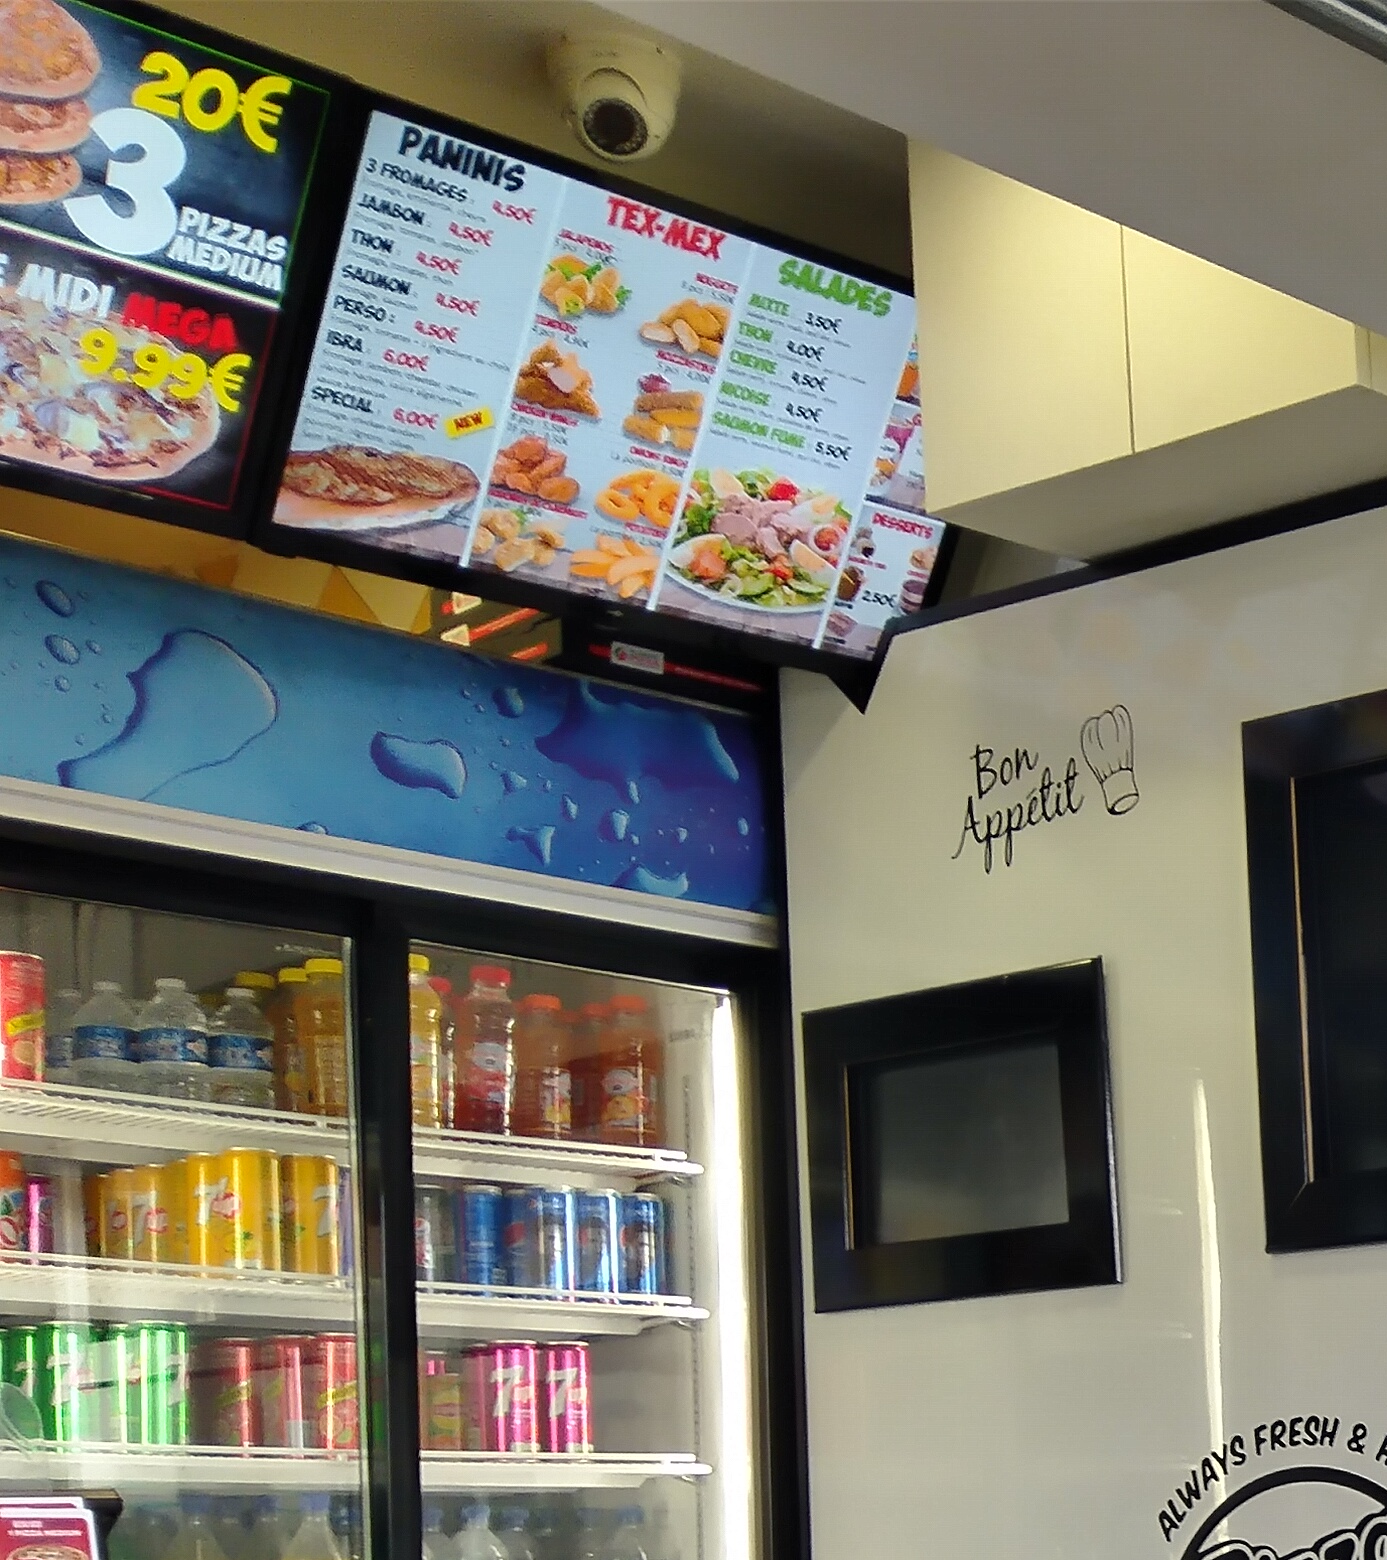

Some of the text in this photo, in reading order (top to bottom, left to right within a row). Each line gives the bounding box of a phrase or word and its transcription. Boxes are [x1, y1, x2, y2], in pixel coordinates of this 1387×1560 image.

[131, 50, 293, 154] 20€
[63, 107, 187, 256] 3
[365, 158, 378, 173] 3
[380, 162, 468, 202] FROMAGES
[397, 125, 527, 191] PANINIS
[178, 205, 289, 261] PIZZAS
[357, 192, 425, 226] JAMBON
[606, 195, 727, 262] TEX-MEX
[166, 235, 285, 292] MEDIUM
[350, 228, 395, 254] THON
[16, 263, 116, 320] MIDI
[121, 292, 238, 354] MEGA
[333, 293, 387, 322] PERSO
[778, 258, 893, 318] SALADES
[325, 328, 364, 353] IBRA
[78, 328, 253, 413] 9.99€
[310, 385, 374, 414] SPECIAL
[453, 411, 484, 432] NEW
[871, 511, 934, 540] DESSERTS
[970, 744, 1039, 800] Bon
[951, 757, 1086, 875] Appétit
[1157, 1434, 1247, 1543] ALWAYS
[1254, 1415, 1340, 1456] FRESH
[1347, 1423, 1368, 1454] &
